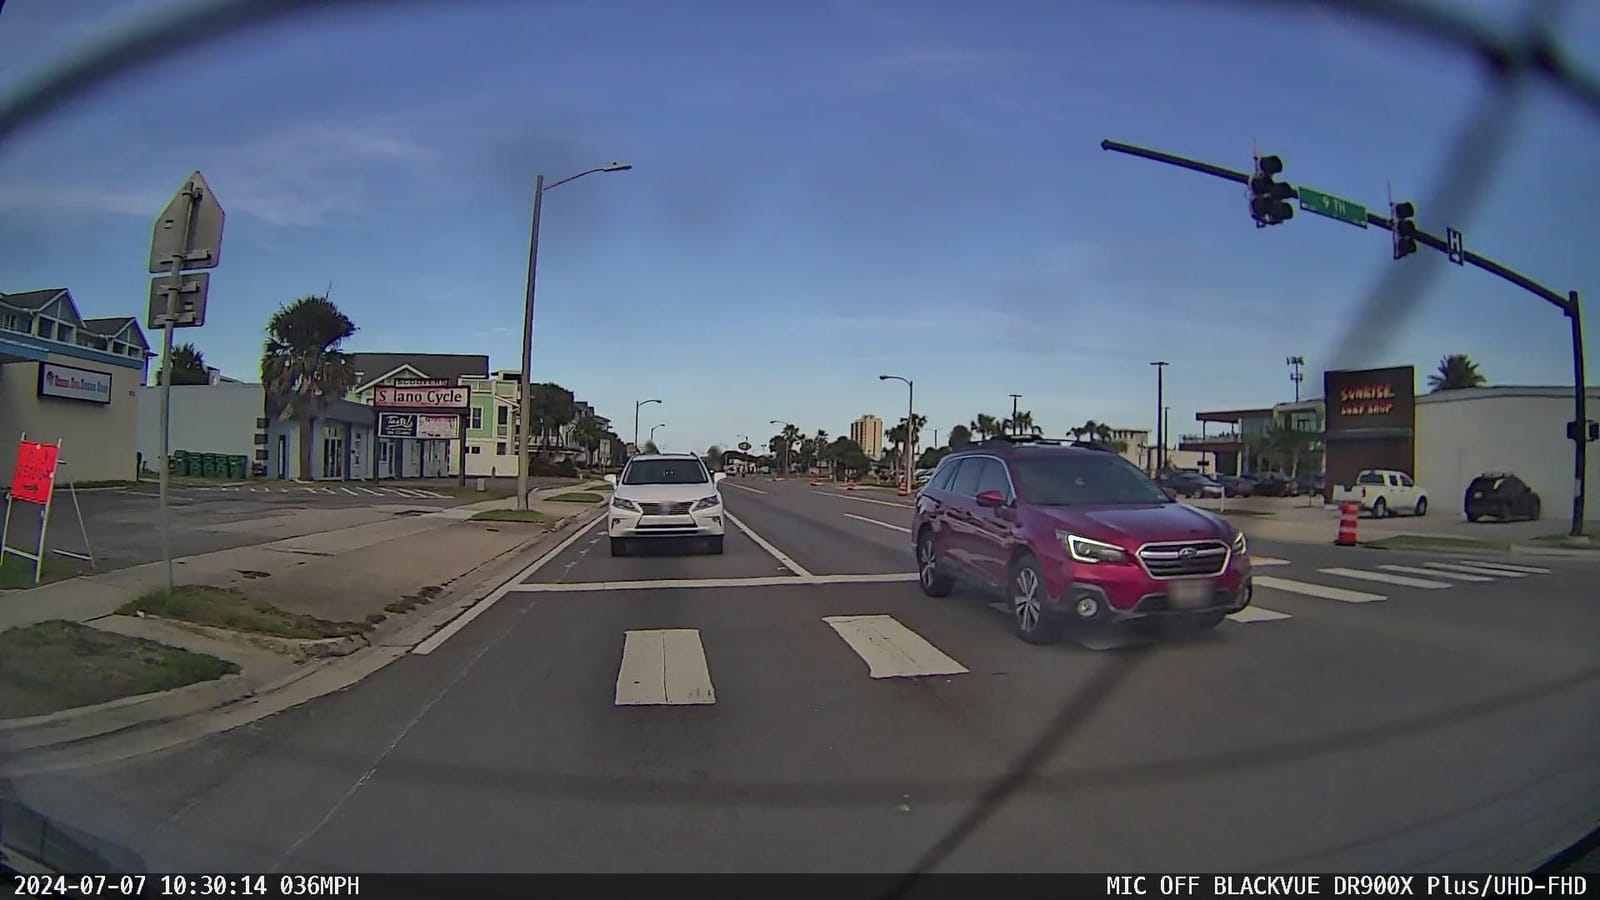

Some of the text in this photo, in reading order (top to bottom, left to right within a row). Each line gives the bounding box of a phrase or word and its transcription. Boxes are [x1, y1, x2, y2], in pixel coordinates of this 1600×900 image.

[1322, 196, 1330, 209] 9
[1450, 230, 1460, 251] H
[427, 390, 463, 405] Cycle
